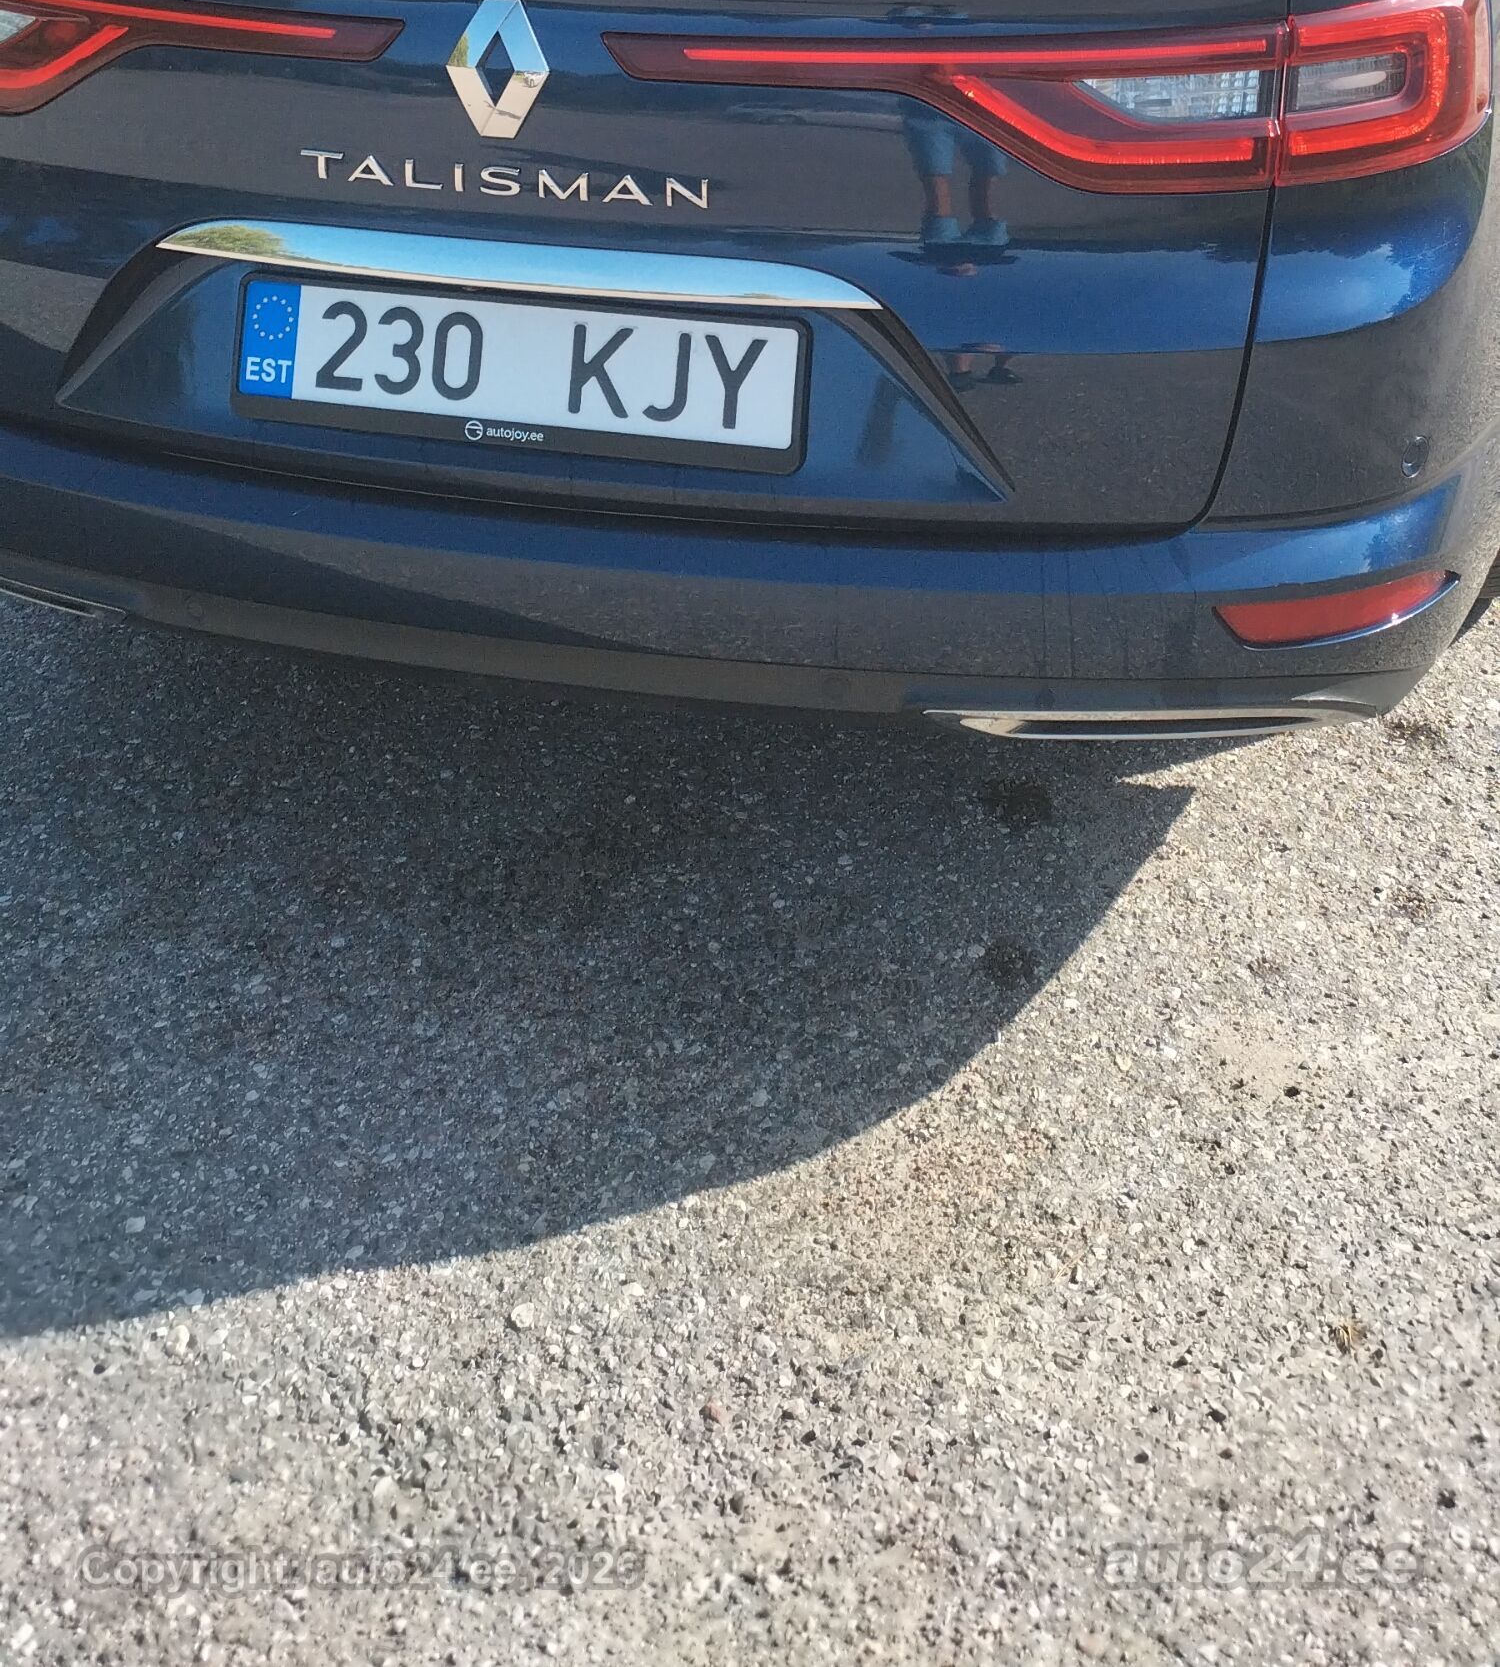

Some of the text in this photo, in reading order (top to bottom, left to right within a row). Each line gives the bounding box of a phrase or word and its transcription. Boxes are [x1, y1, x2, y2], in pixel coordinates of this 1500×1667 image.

[300, 148, 709, 209] TALISMAN
[245, 355, 293, 385] EST
[315, 300, 768, 430] 230 KJY
[486, 427, 544, 442] autojoy.ee
